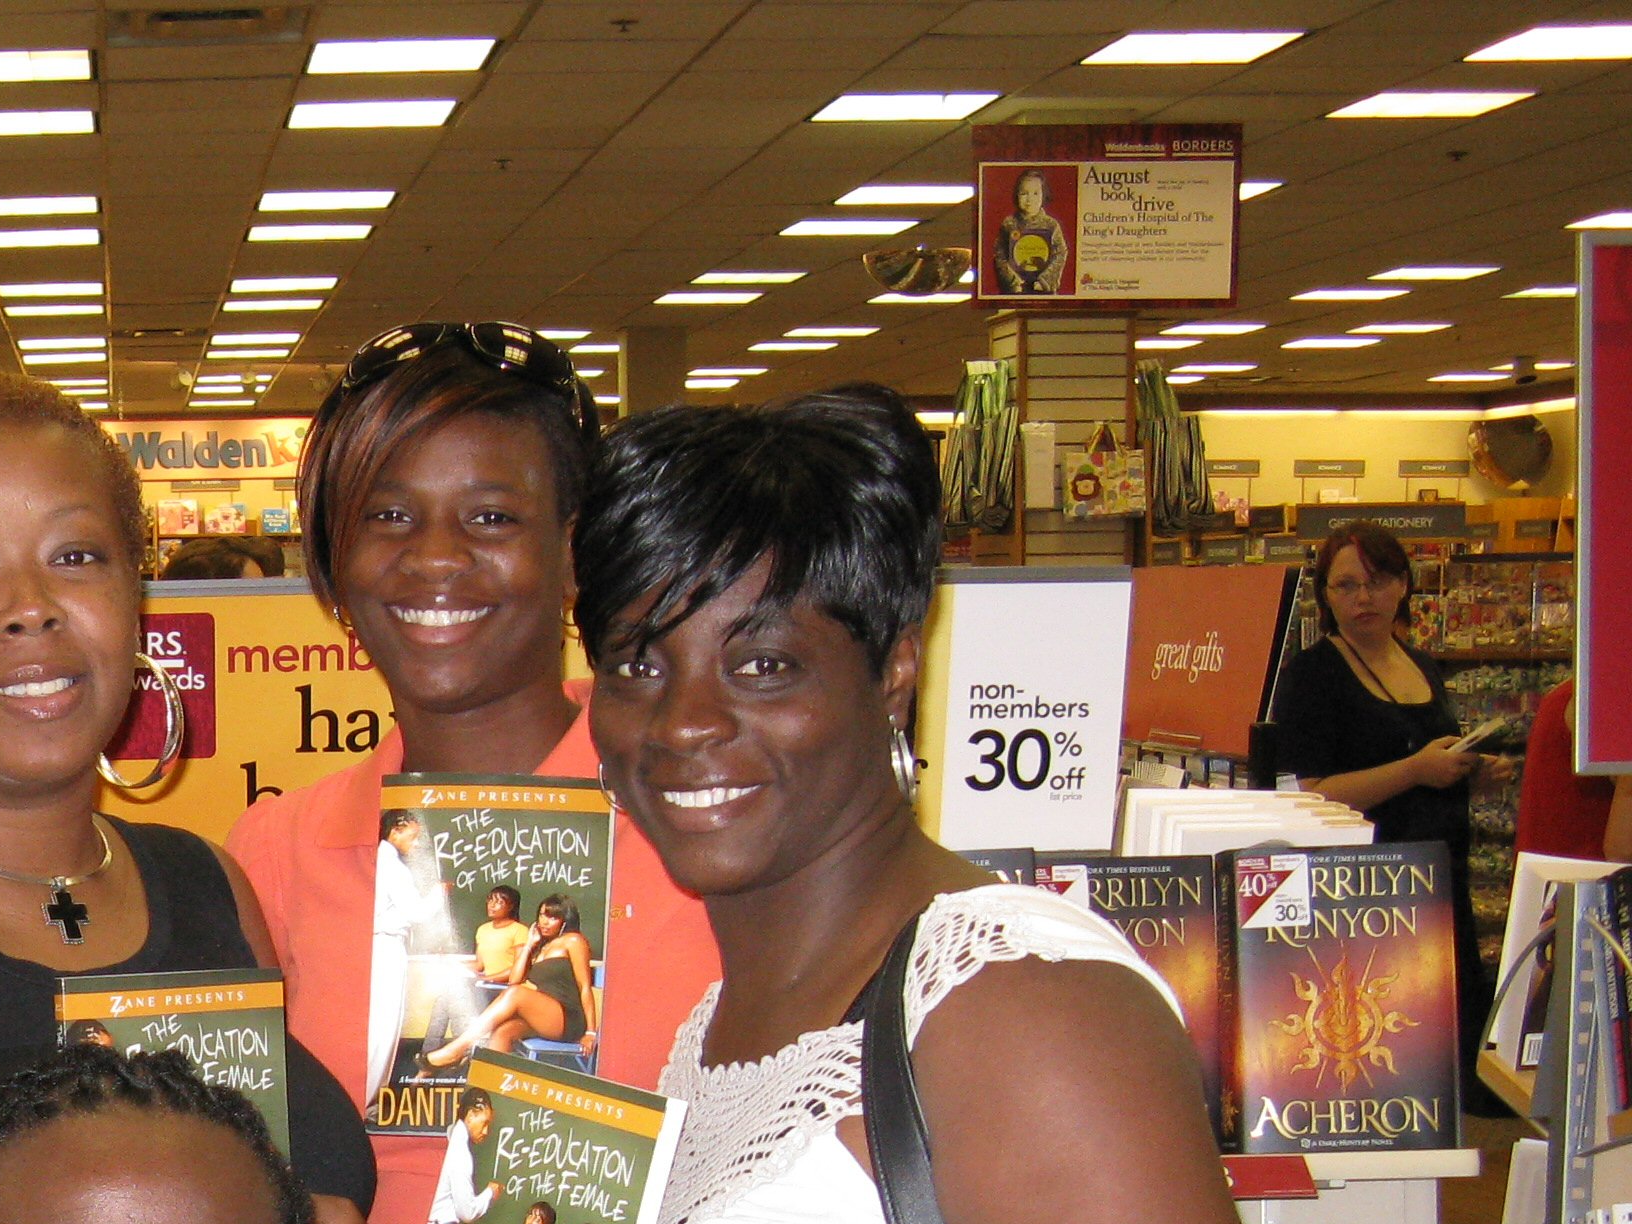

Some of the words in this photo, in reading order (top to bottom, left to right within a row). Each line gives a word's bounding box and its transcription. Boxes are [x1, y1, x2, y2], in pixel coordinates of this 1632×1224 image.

[1172, 140, 1233, 151] BORDERS
[1083, 165, 1150, 190] August
[1101, 187, 1135, 201] book
[1132, 195, 1174, 211] drive
[1083, 212, 1134, 223] Children's
[1137, 212, 1179, 225] Hospital
[1181, 212, 1193, 222] of
[1193, 211, 1214, 223] The
[1083, 226, 1114, 239] King's
[1116, 226, 1167, 239] Daughters
[1152, 640, 1191, 680] great
[1188, 631, 1224, 683] gifts
[969, 683, 1025, 700] non-
[969, 696, 1089, 720] members
[1050, 767, 1086, 791] off
[479, 791, 567, 804] PRESENTS
[451, 808, 495, 833] THE
[433, 818, 590, 880] RE-EDUCATION
[1333, 855, 1356, 863] TIMES
[1357, 854, 1403, 862] BESTSELLER
[456, 870, 476, 892] OF
[480, 858, 511, 883] THE
[515, 854, 592, 887] FEMALE
[1129, 866, 1171, 874] BESTSELLER
[1311, 864, 1434, 900] RRILYN
[165, 990, 245, 1006] PRESENTS
[141, 1013, 183, 1043] THE
[202, 1061, 274, 1091] FEMALE
[546, 1089, 625, 1119] PRESENTS
[519, 1106, 556, 1133] THE
[1250, 1096, 1440, 1139] ACHERON
[493, 1127, 636, 1188] RE-EDUCATION
[506, 1175, 527, 1201] OF
[529, 1170, 556, 1198] THE
[556, 1170, 629, 1222] FEMALE
